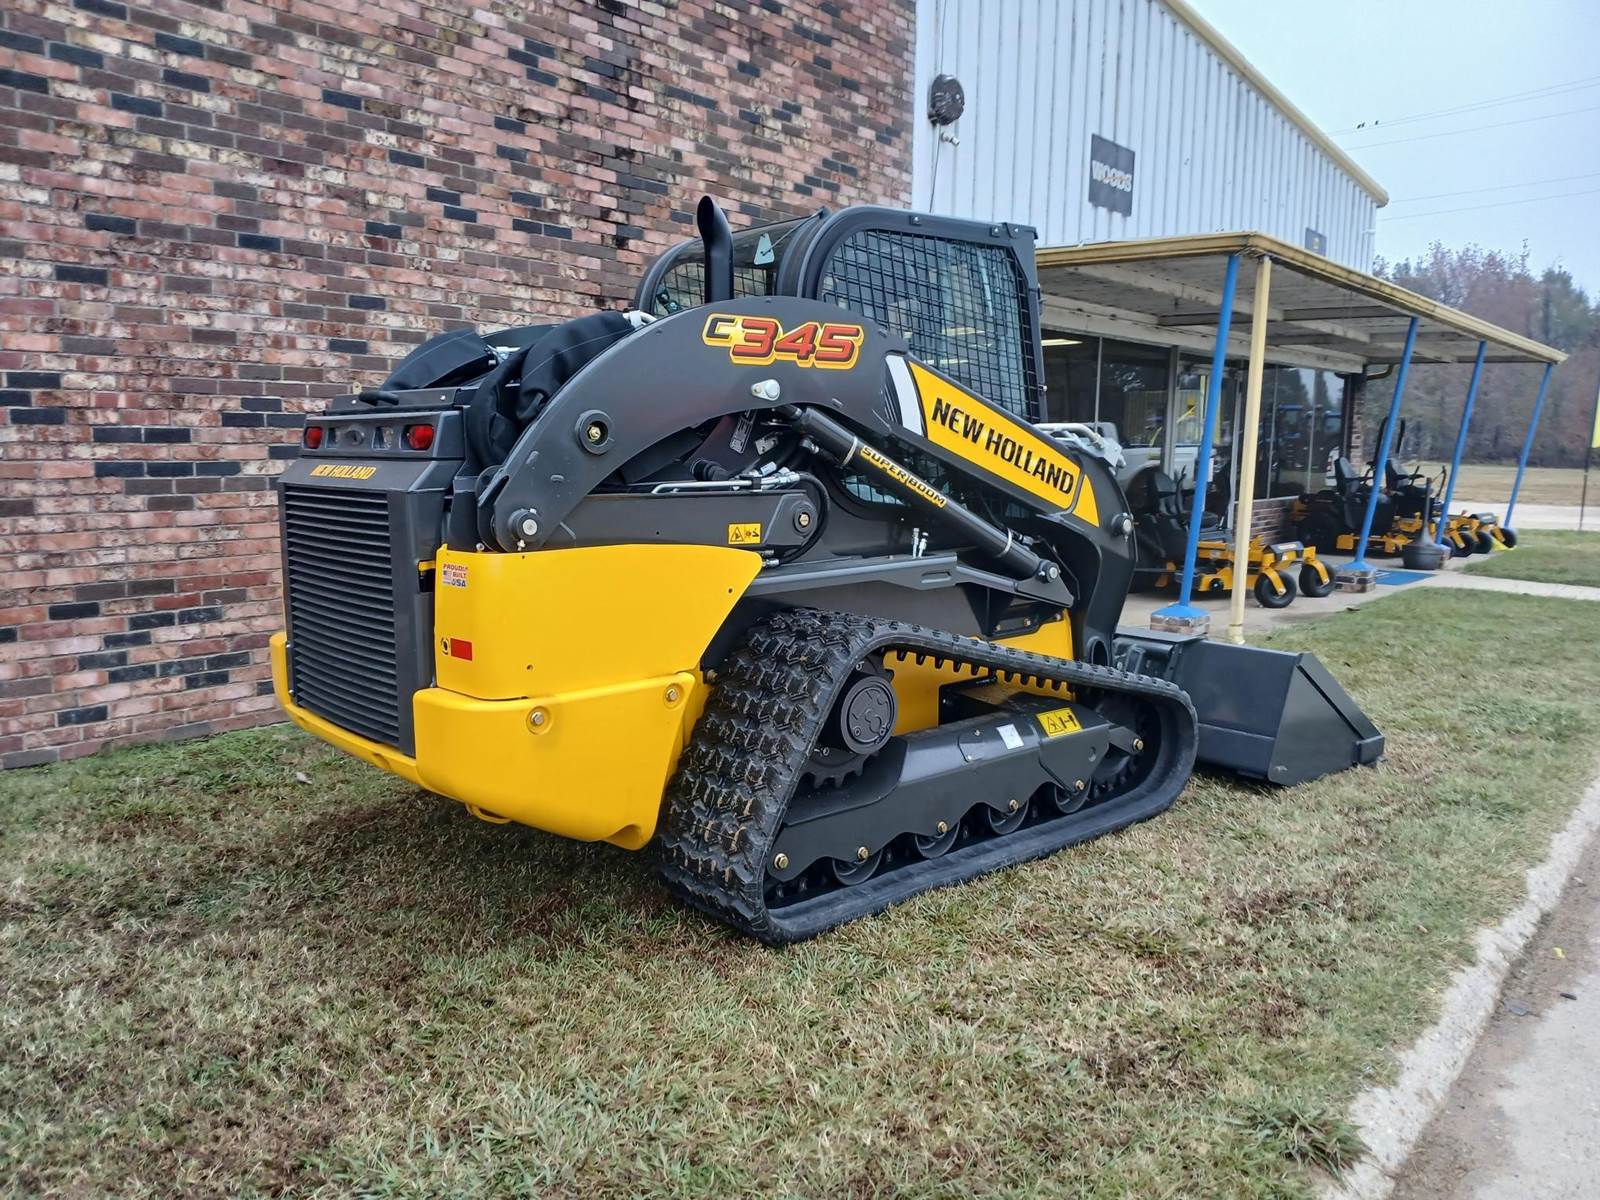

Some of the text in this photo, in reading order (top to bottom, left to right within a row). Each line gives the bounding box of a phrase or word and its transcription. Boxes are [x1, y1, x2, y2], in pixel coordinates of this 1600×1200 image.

[702, 313, 865, 370] C345
[310, 464, 377, 480] NEW HOLLAND
[931, 397, 1074, 495] NEW HOLLAND
[861, 446, 947, 508] SUPER BOOM
[452, 578, 466, 587] USA
